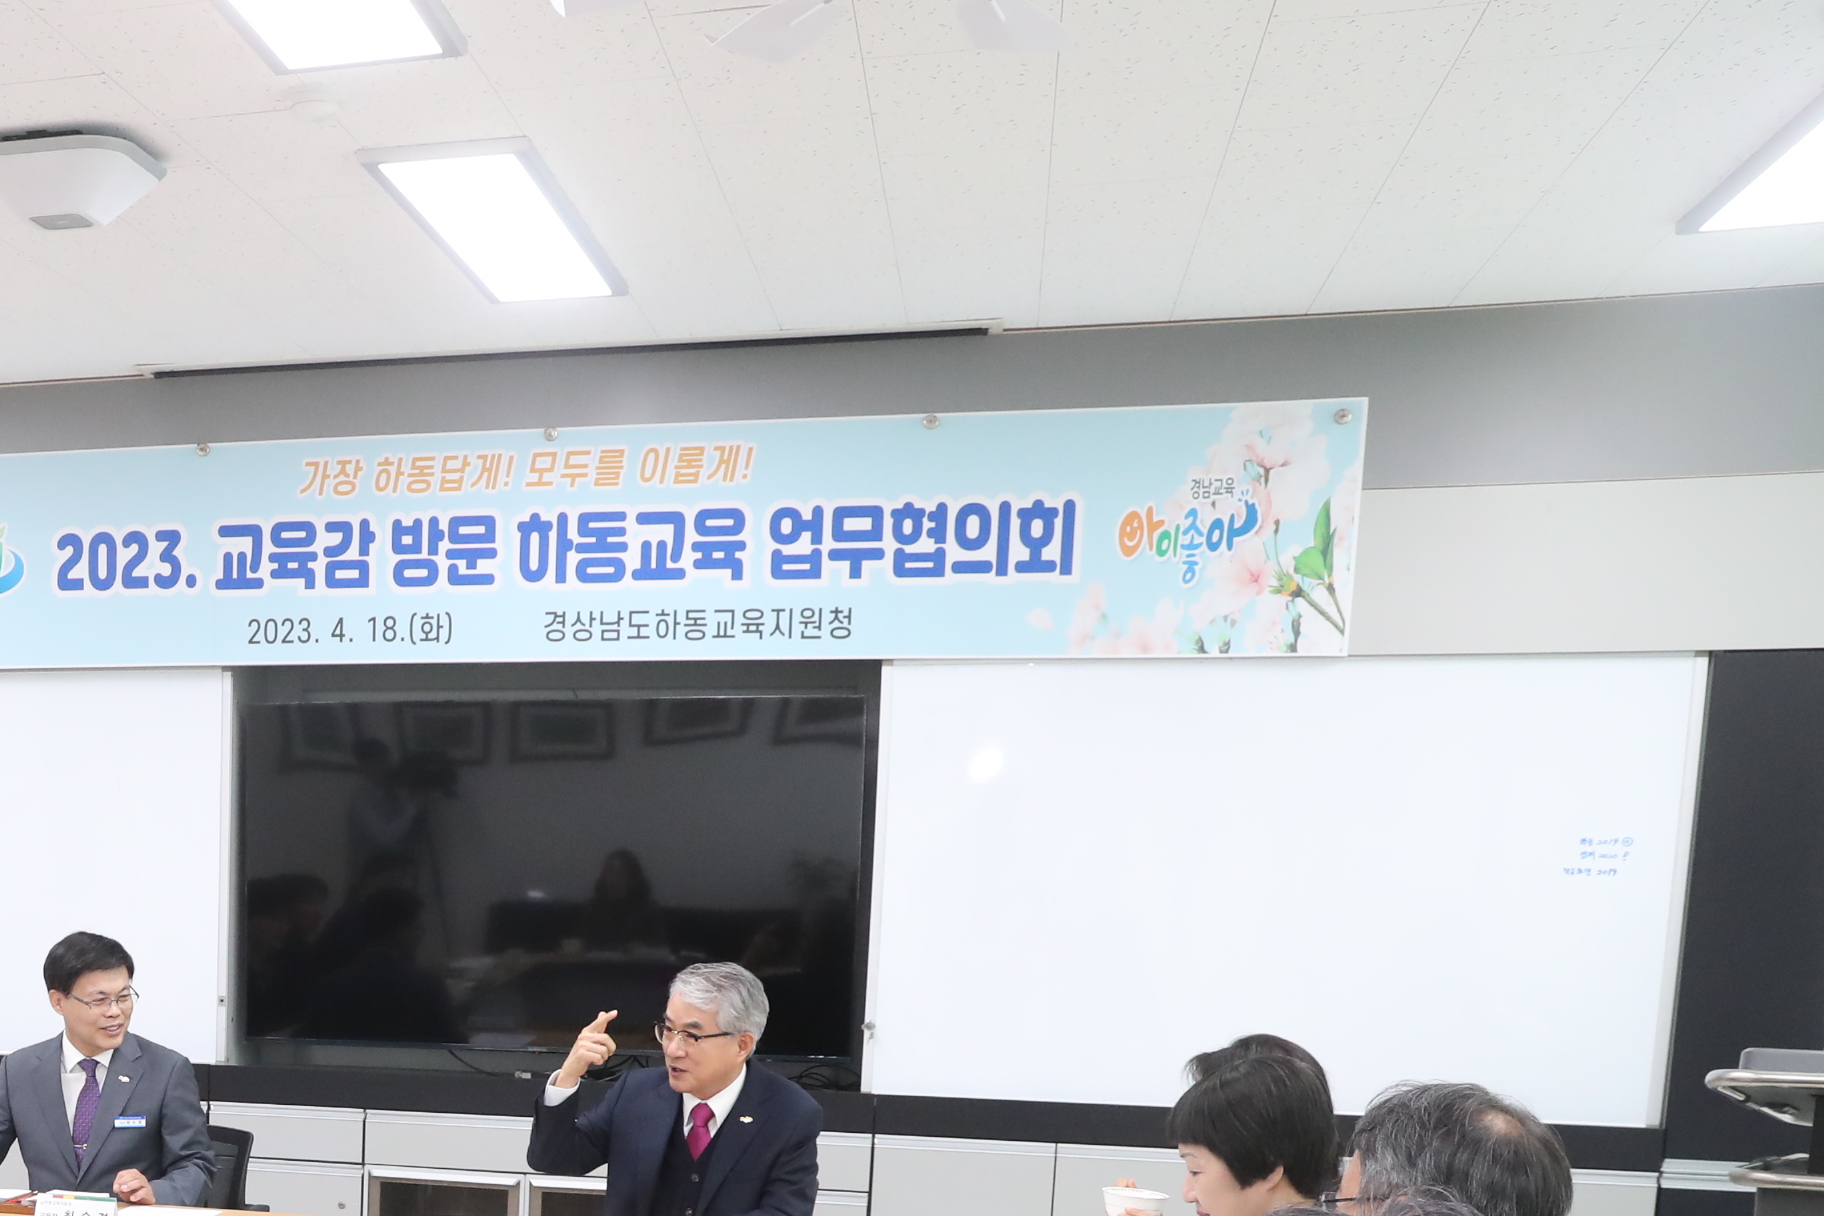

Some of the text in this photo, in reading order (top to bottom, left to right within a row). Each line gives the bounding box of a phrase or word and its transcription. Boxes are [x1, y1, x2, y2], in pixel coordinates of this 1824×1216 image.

[301, 445, 755, 496] 가장 하동답게! 모두를 이롭게!
[1190, 477, 1236, 500] 경남교육
[59, 499, 1076, 591] 2023. 교육감 방문 하동교육 업무협의회
[1119, 499, 1259, 585] 아이좋아
[247, 611, 453, 646] 2023. 4. 18.(화)
[543, 606, 853, 643] 경상남도하동교육지원청
